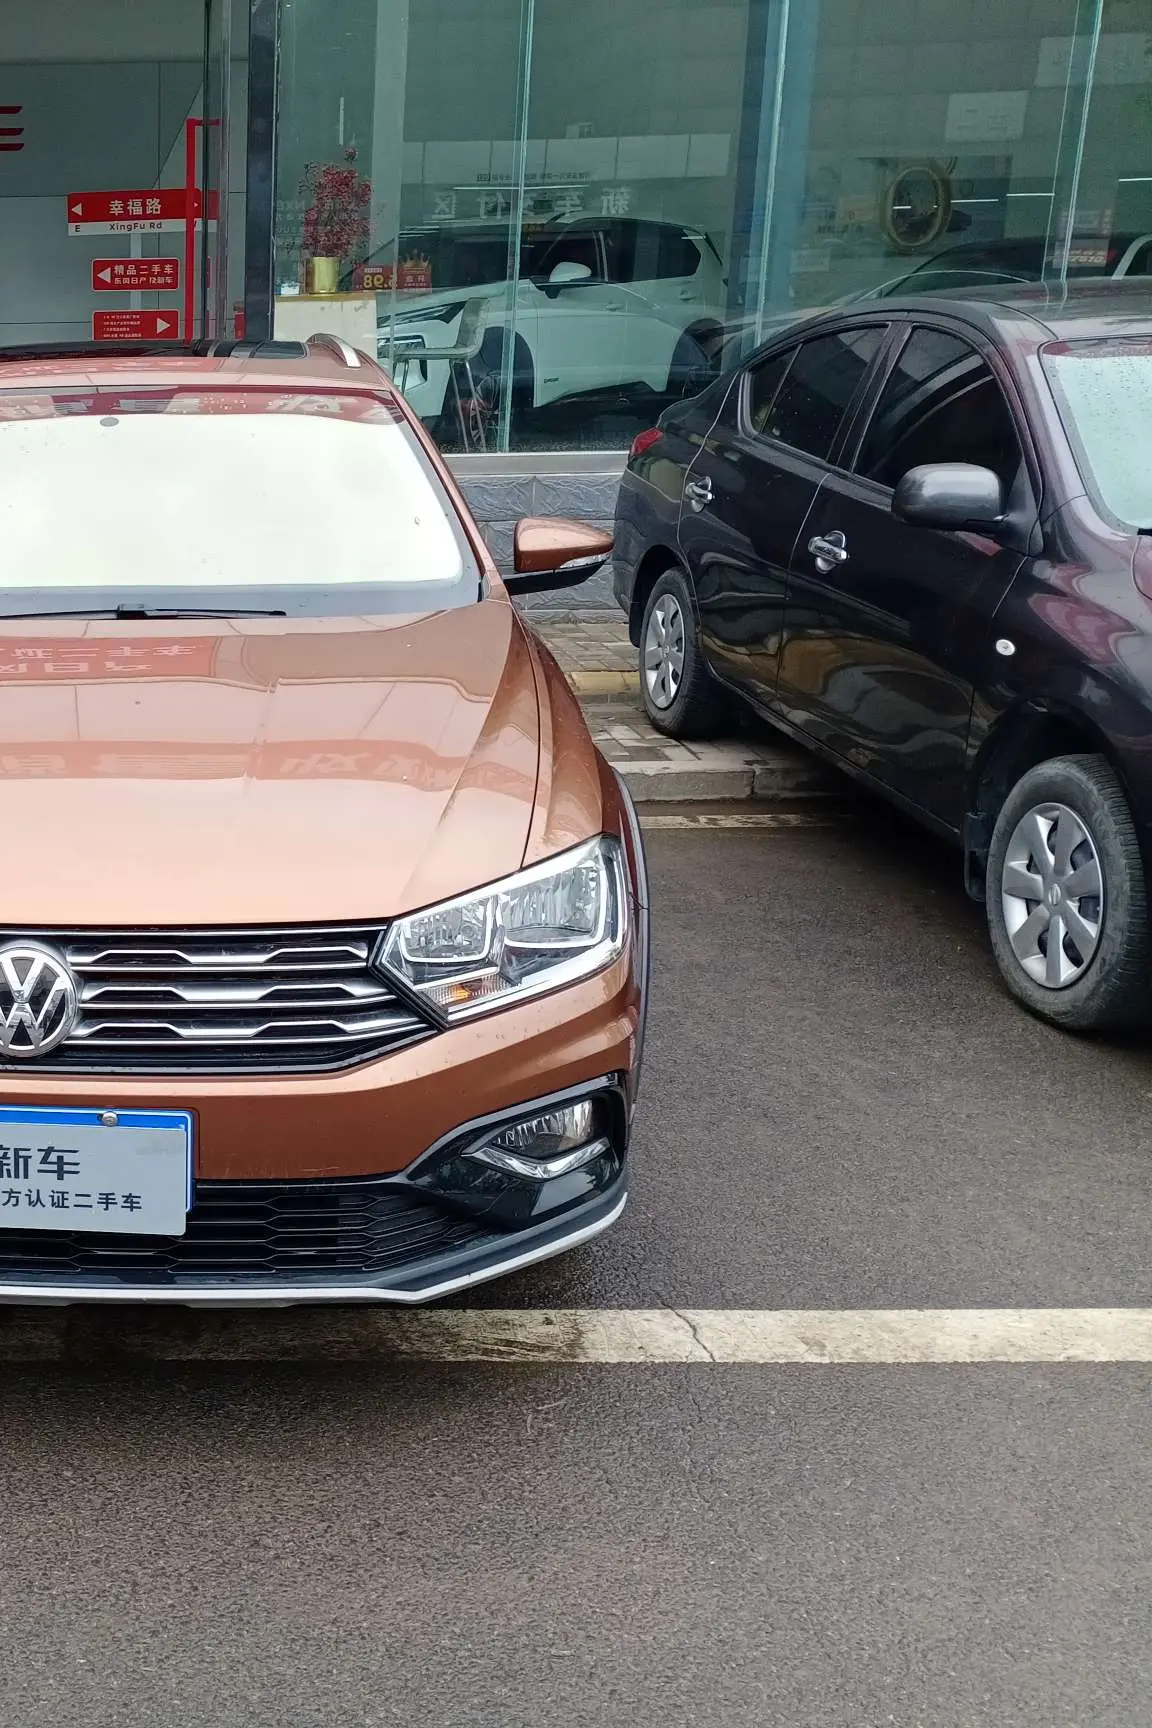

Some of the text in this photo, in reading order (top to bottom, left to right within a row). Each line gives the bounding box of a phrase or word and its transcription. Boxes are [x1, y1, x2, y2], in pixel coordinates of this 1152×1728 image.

[109, 198, 162, 216] 幸福路
[74, 221, 163, 232] E XingFu Rd
[114, 264, 174, 275] 精品二手车
